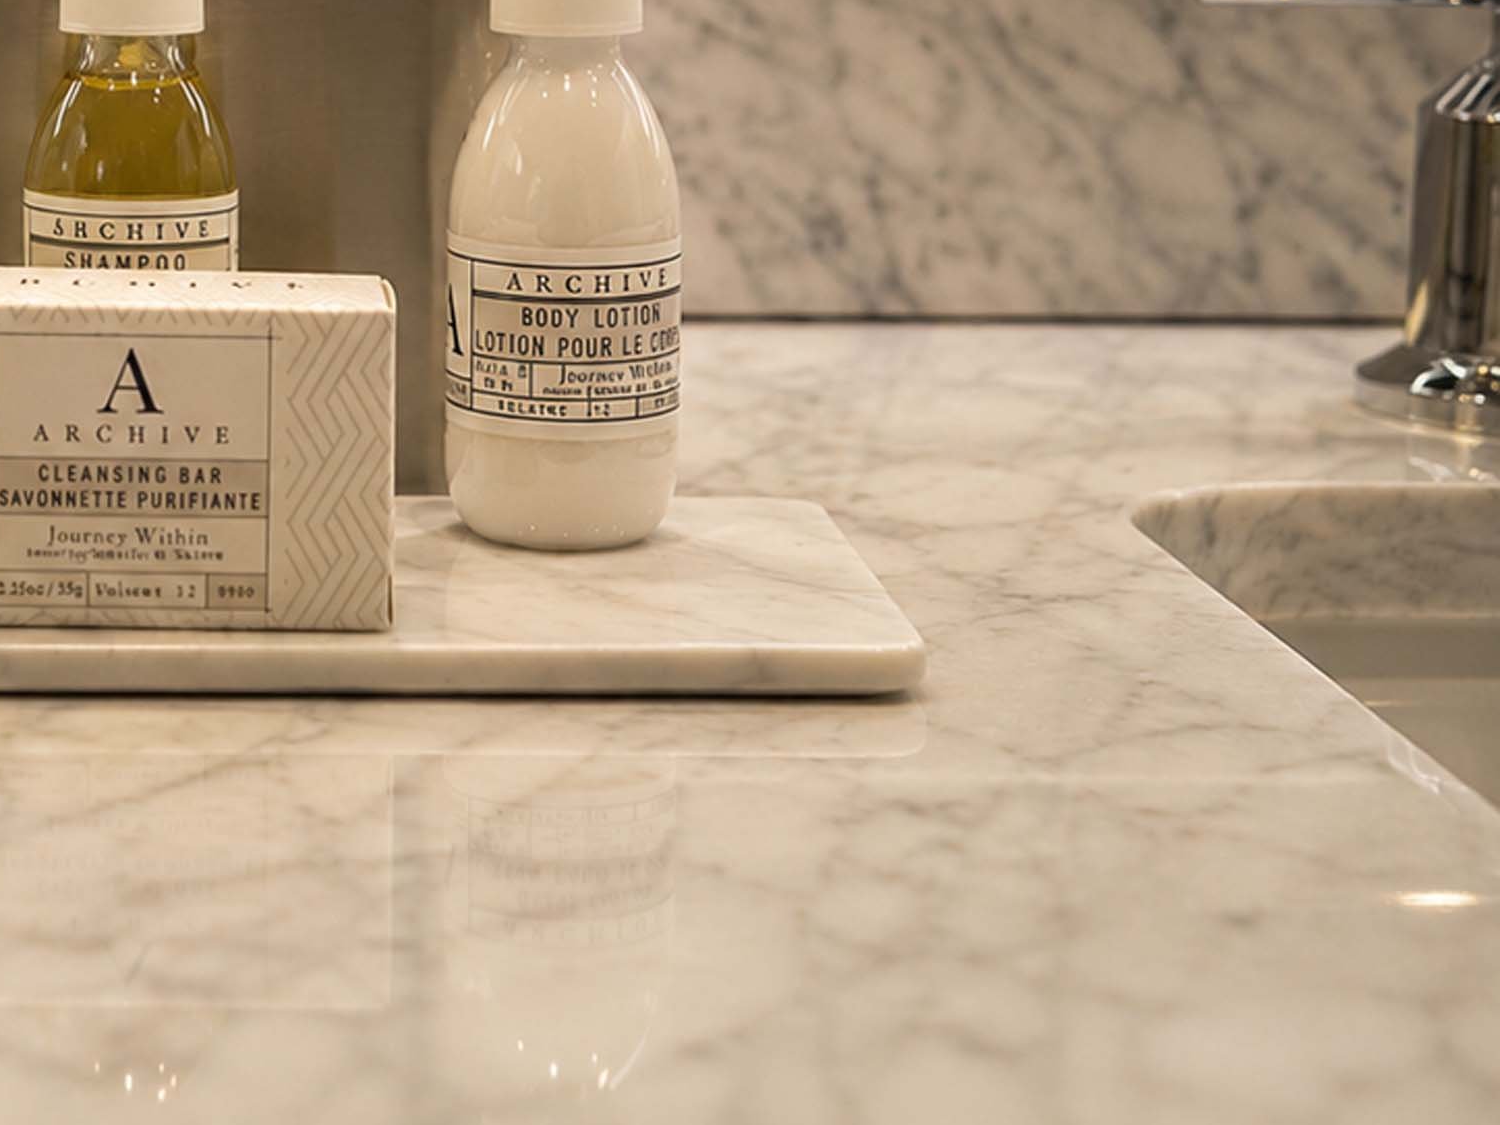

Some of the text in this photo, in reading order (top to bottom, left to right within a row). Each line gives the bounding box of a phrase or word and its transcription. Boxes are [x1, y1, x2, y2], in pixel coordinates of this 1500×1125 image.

[506, 268, 668, 294] ARCHIVE
[521, 302, 661, 328] BODY LOTION
[475, 331, 545, 357] LOTION
[558, 337, 612, 359] POUR
[622, 333, 642, 355] LE
[97, 347, 164, 414] A
[33, 424, 230, 444] ARCHIVE
[38, 464, 222, 484] CLEANSING BAR
[137, 491, 261, 510] PURIFIANTE
[47, 524, 209, 547] Journey Within
